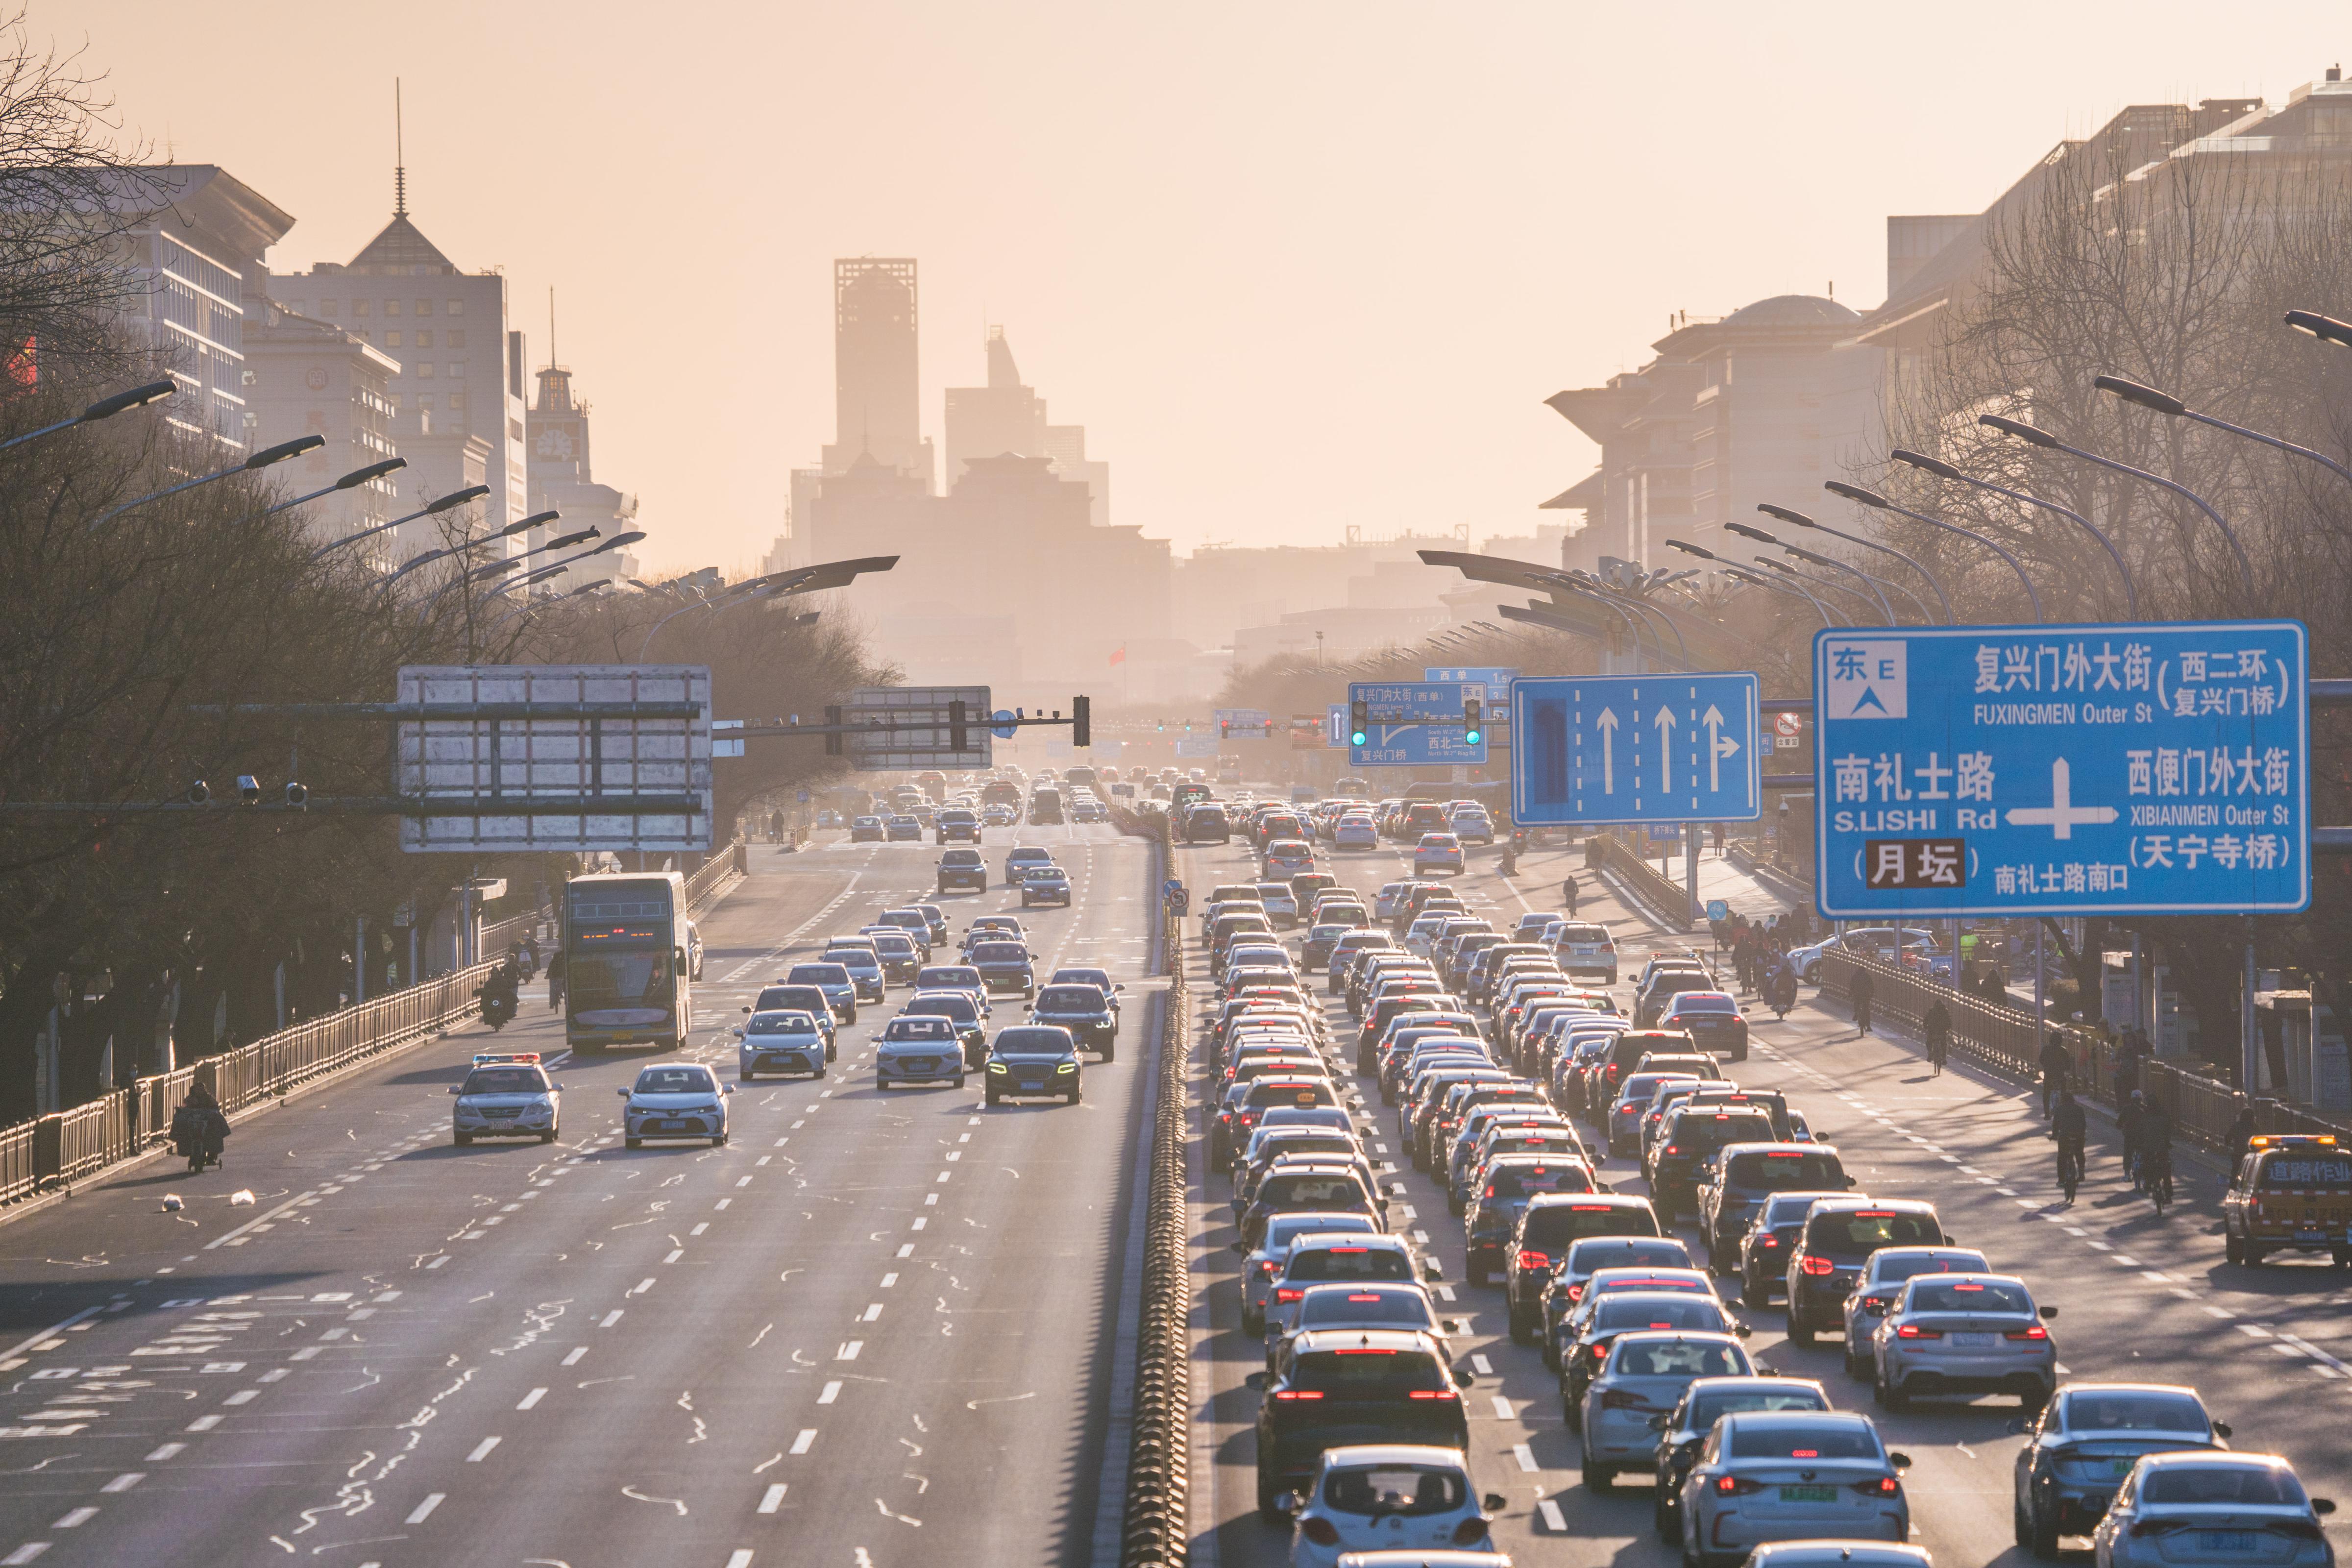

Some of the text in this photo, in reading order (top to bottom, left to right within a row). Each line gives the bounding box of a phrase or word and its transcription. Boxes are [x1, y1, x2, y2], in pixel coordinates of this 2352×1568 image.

[1440, 670, 1467, 680] 西单
[1833, 647, 1895, 681] 东 E
[1975, 642, 2152, 693] 复兴门外大街
[1463, 687, 1472, 696] 东
[2174, 686, 2275, 717] 复兴门桥
[1974, 702, 2153, 725] FUXINGMEN Outer St
[1361, 749, 1407, 761] 复兴门桥
[1833, 751, 1995, 802] 南礼士路
[2126, 746, 2290, 796] 西便门外大街
[1834, 808, 1996, 833] S.LISHI Rd
[2131, 804, 2289, 826] XIBIANMEN Outer St
[2130, 833, 2290, 870] (天宁寺桥)
[1994, 862, 2128, 895] 南礼士路南口
